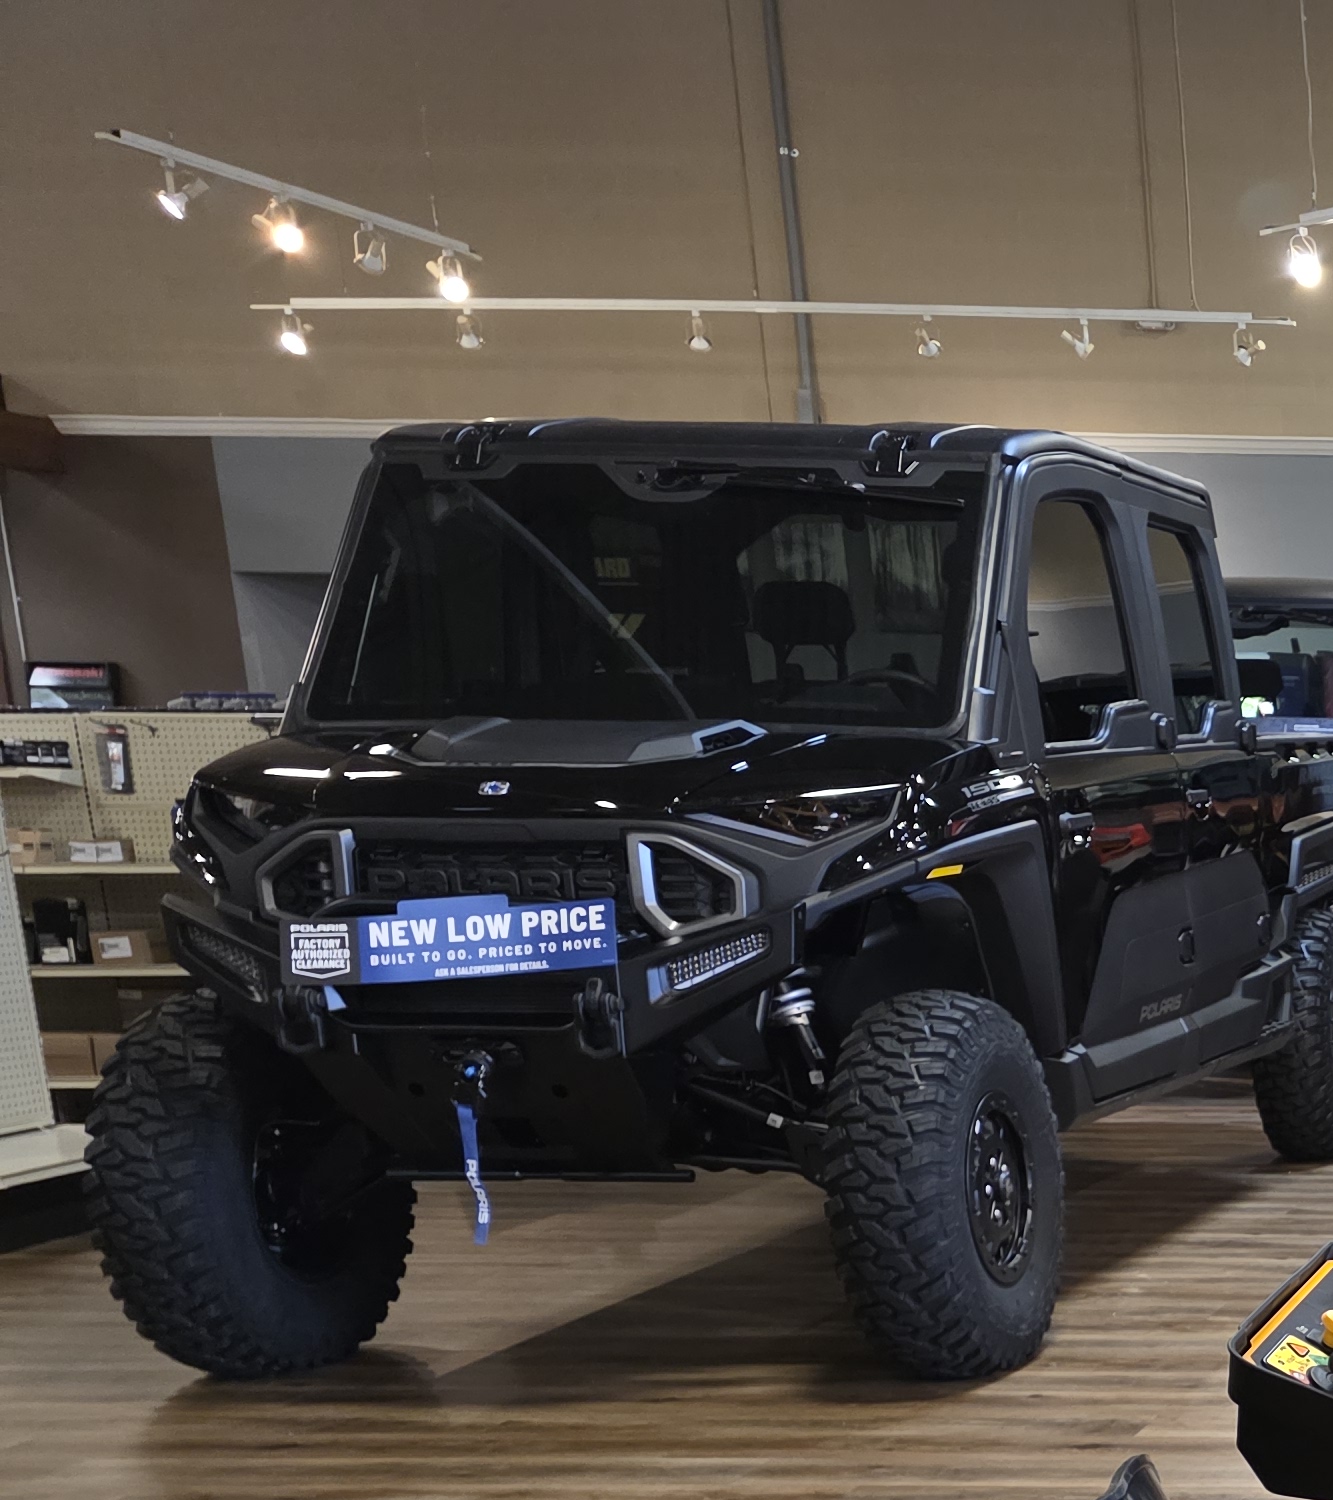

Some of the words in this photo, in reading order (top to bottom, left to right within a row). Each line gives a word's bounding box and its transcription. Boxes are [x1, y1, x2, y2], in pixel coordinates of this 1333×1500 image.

[372, 868, 615, 899] POLARIS
[290, 924, 348, 932] POLARIS
[368, 917, 437, 949] NEW
[447, 912, 512, 943] LOW
[522, 904, 606, 937] PRICE
[298, 938, 341, 949] FACTORY
[370, 952, 415, 966] BUILT
[422, 951, 441, 963] TO
[479, 944, 533, 959] PRICED
[539, 942, 556, 953] TO
[563, 937, 608, 951] MOVE.
[291, 949, 350, 960] AUTHORIZED
[296, 960, 346, 969] CLEARANCE
[450, 967, 456, 976] A
[1140, 993, 1183, 1023] POLARIS
[466, 1159, 490, 1224] POLARIS
